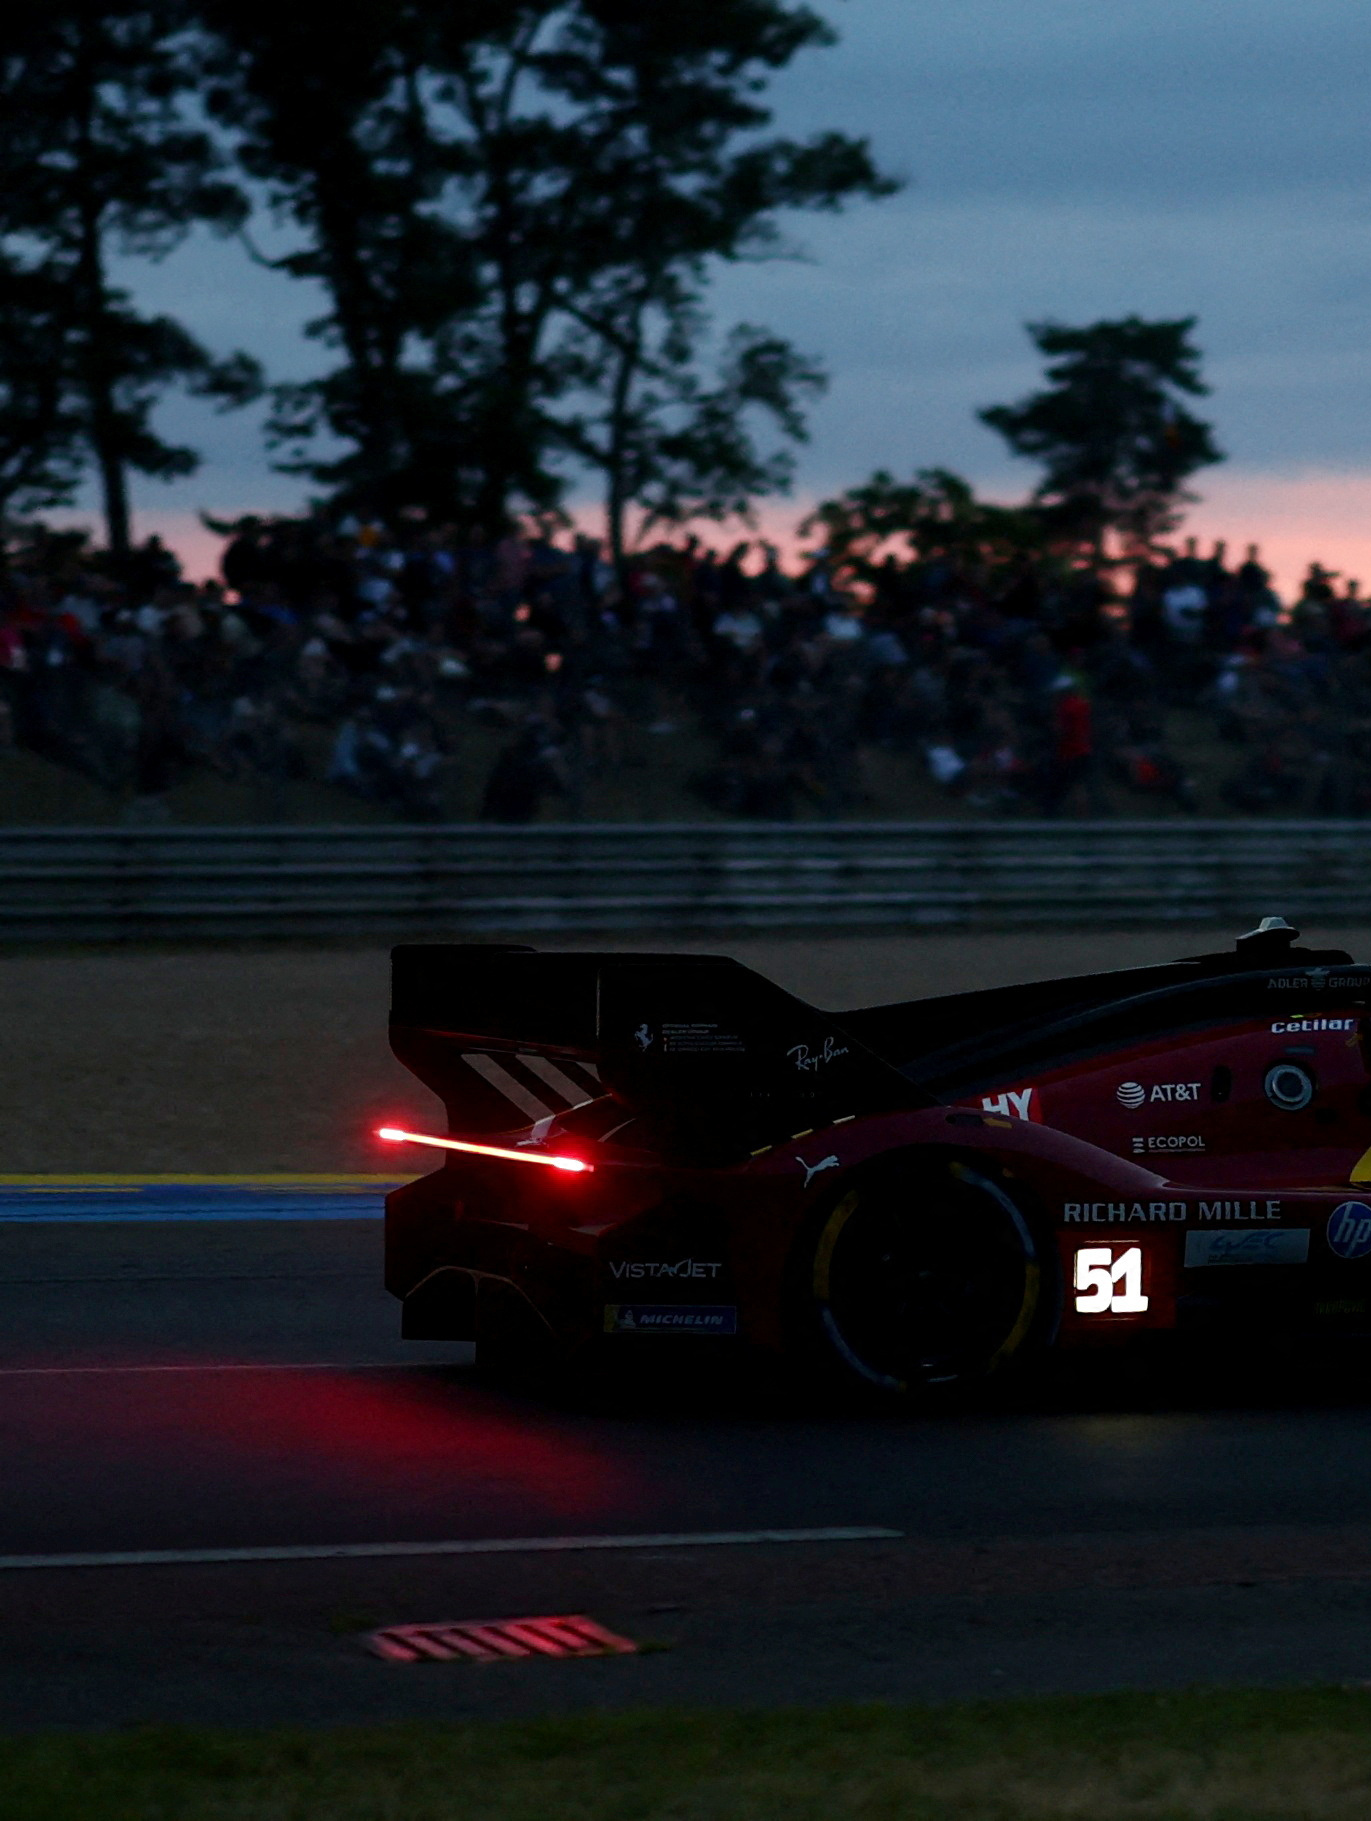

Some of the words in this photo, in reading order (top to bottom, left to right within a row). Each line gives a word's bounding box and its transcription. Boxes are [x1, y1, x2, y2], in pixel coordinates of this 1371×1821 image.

[1266, 976, 1308, 990] ADLER
[1328, 975, 1371, 989] GROUP
[786, 1036, 850, 1072] Ray-Ban
[1150, 1082, 1201, 1103] AT&T
[981, 1087, 1033, 1121] HY
[1148, 1135, 1206, 1149] ECOPOL
[1063, 1201, 1188, 1223] RICHARD
[1198, 1200, 1283, 1221] MILLE
[1074, 1246, 1150, 1314] 51
[639, 1314, 725, 1326] MICHELIN
